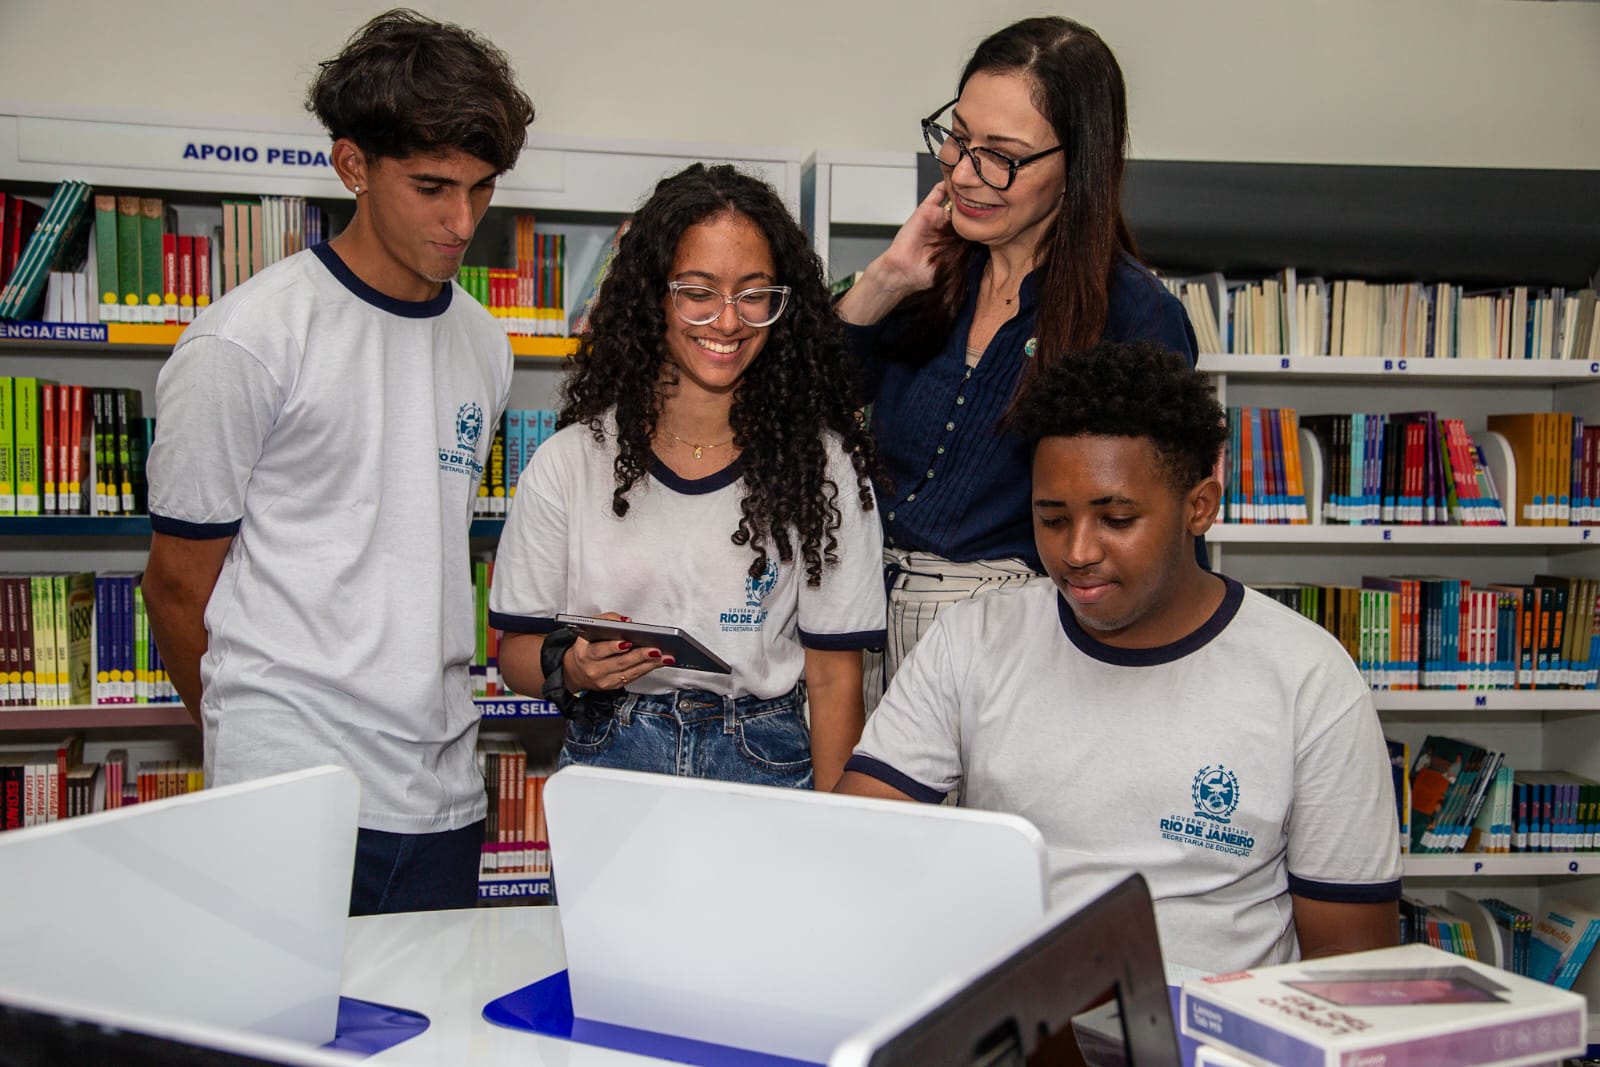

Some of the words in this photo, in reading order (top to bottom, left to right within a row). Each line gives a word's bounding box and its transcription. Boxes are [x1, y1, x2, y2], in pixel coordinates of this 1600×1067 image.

[183, 144, 258, 163] APOIO
[267, 148, 332, 167] PEDA
[1281, 358, 1289, 369] B
[1384, 360, 1392, 370] B
[1398, 360, 1407, 370] C
[1590, 362, 1599, 373] C
[450, 455, 463, 464] DE
[1383, 530, 1391, 540] E
[1583, 530, 1591, 540] F
[720, 613, 739, 623] RIO
[740, 614, 752, 623] DE
[1475, 696, 1486, 706] M
[478, 704, 516, 715] BRAS
[520, 703, 560, 715] SELE
[1171, 815, 1207, 827] GOVERNO
[1224, 826, 1248, 836] ESTADO
[1160, 818, 1183, 832] RIO
[1185, 824, 1203, 836] DE
[1205, 829, 1254, 848] JANEIRO
[1162, 833, 1204, 847] SECRETARIA
[1216, 845, 1250, 857] EDUCAÇÃO
[1474, 862, 1483, 872] P
[1569, 862, 1578, 872] Q
[479, 882, 550, 897] TERATUR
